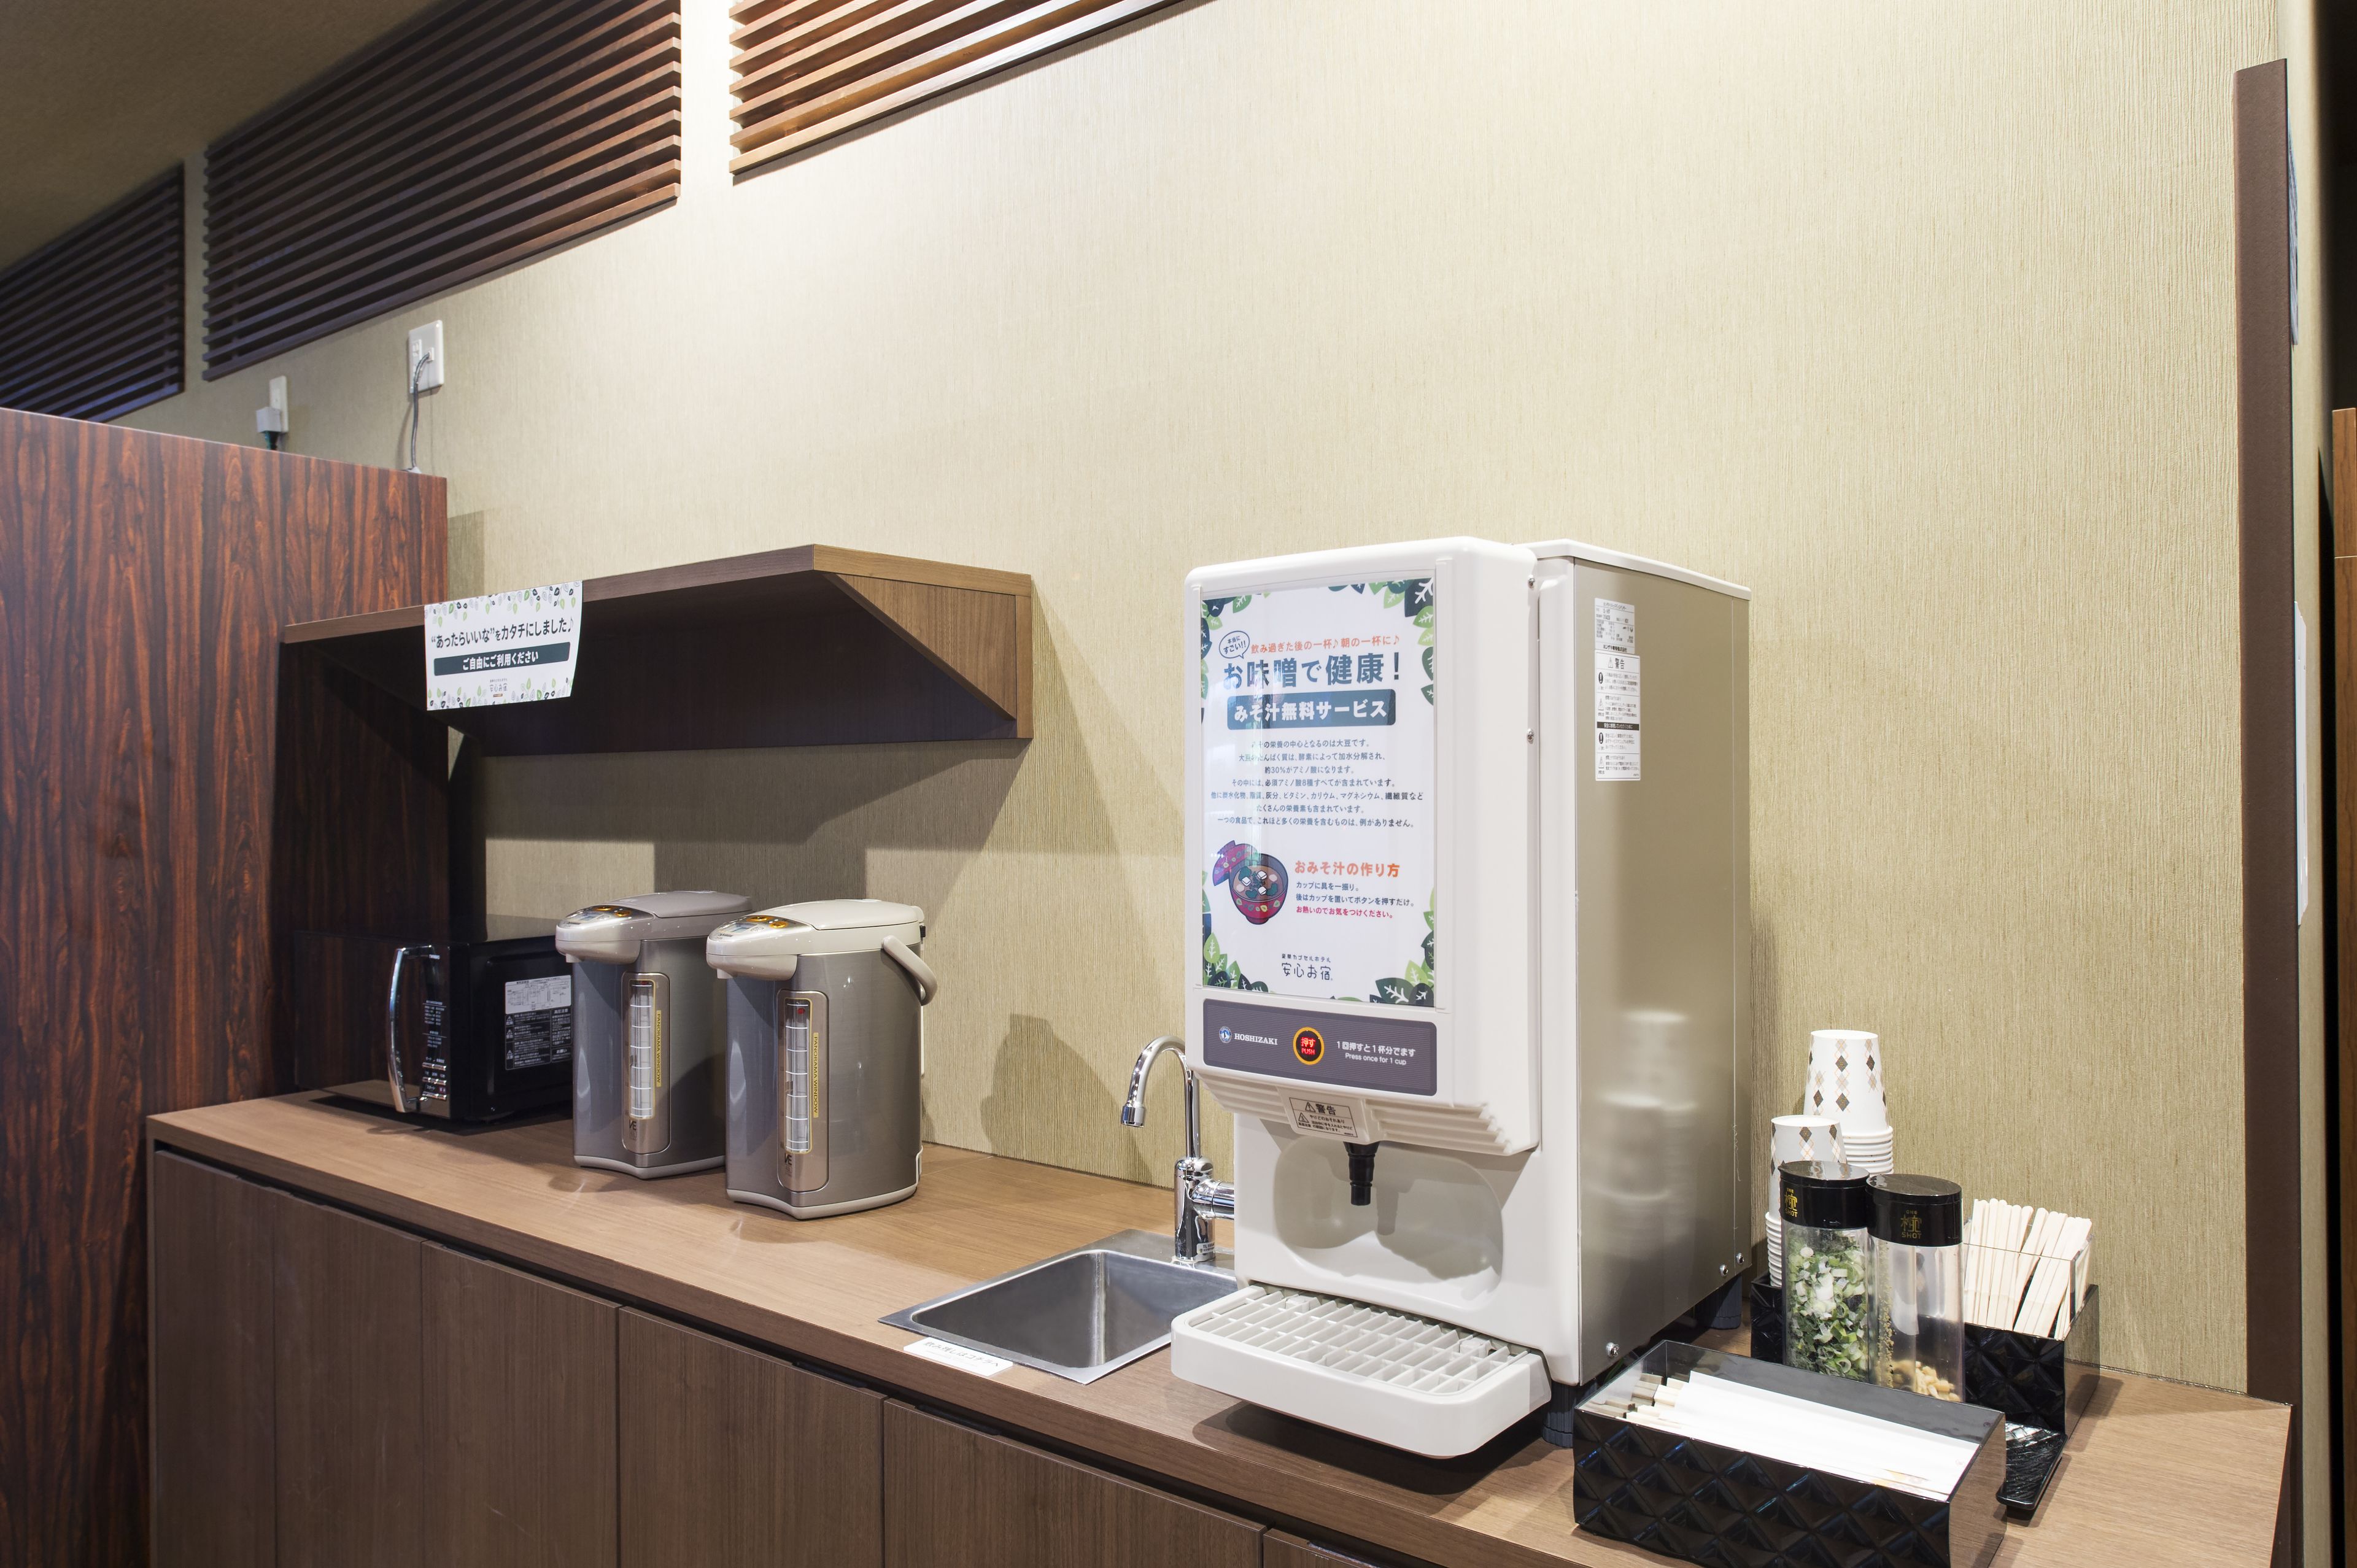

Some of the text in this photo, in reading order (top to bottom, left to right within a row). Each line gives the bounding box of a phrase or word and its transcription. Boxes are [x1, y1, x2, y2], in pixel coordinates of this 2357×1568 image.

[463, 651, 538, 671] ご自由にご利用ください
[1234, 699, 1387, 723] みそ汁無料サービス
[1295, 860, 1399, 878] おみそ汁の作り方
[1296, 881, 1358, 891] カップに具を一振り。
[1296, 893, 1414, 906] 後はカップを置いてボタンを押すだけ。
[1296, 906, 1393, 918] お熱いのでお気をつけください。
[1282, 962, 1331, 980] 安心お宿
[1234, 1033, 1278, 1045] HOSHIZAKI
[1301, 1037, 1315, 1048] 押す
[1315, 1103, 1336, 1115] 警告
[1785, 1208, 1798, 1217] SHOT
